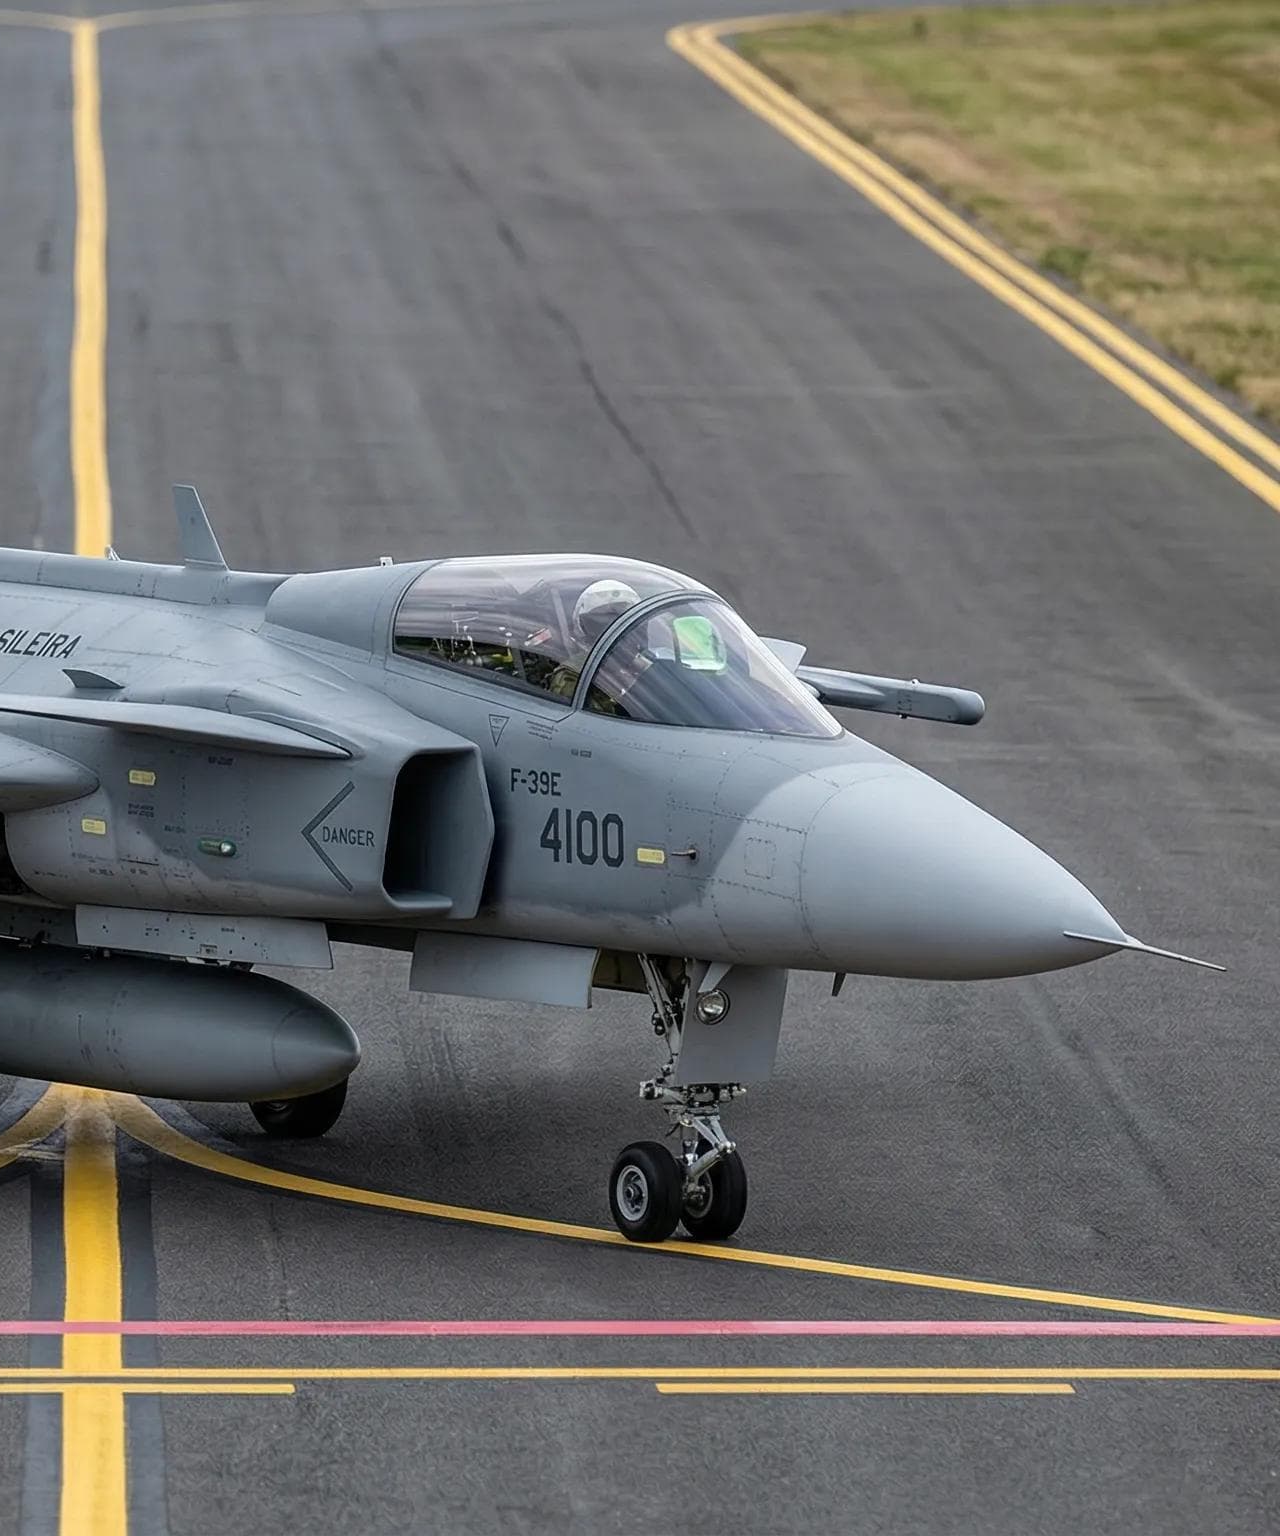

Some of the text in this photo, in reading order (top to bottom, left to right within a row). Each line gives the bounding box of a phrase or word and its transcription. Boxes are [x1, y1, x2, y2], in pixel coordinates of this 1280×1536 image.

[510, 767, 562, 796] F-39E
[322, 825, 375, 848] DANGER
[540, 807, 625, 868] 4100
